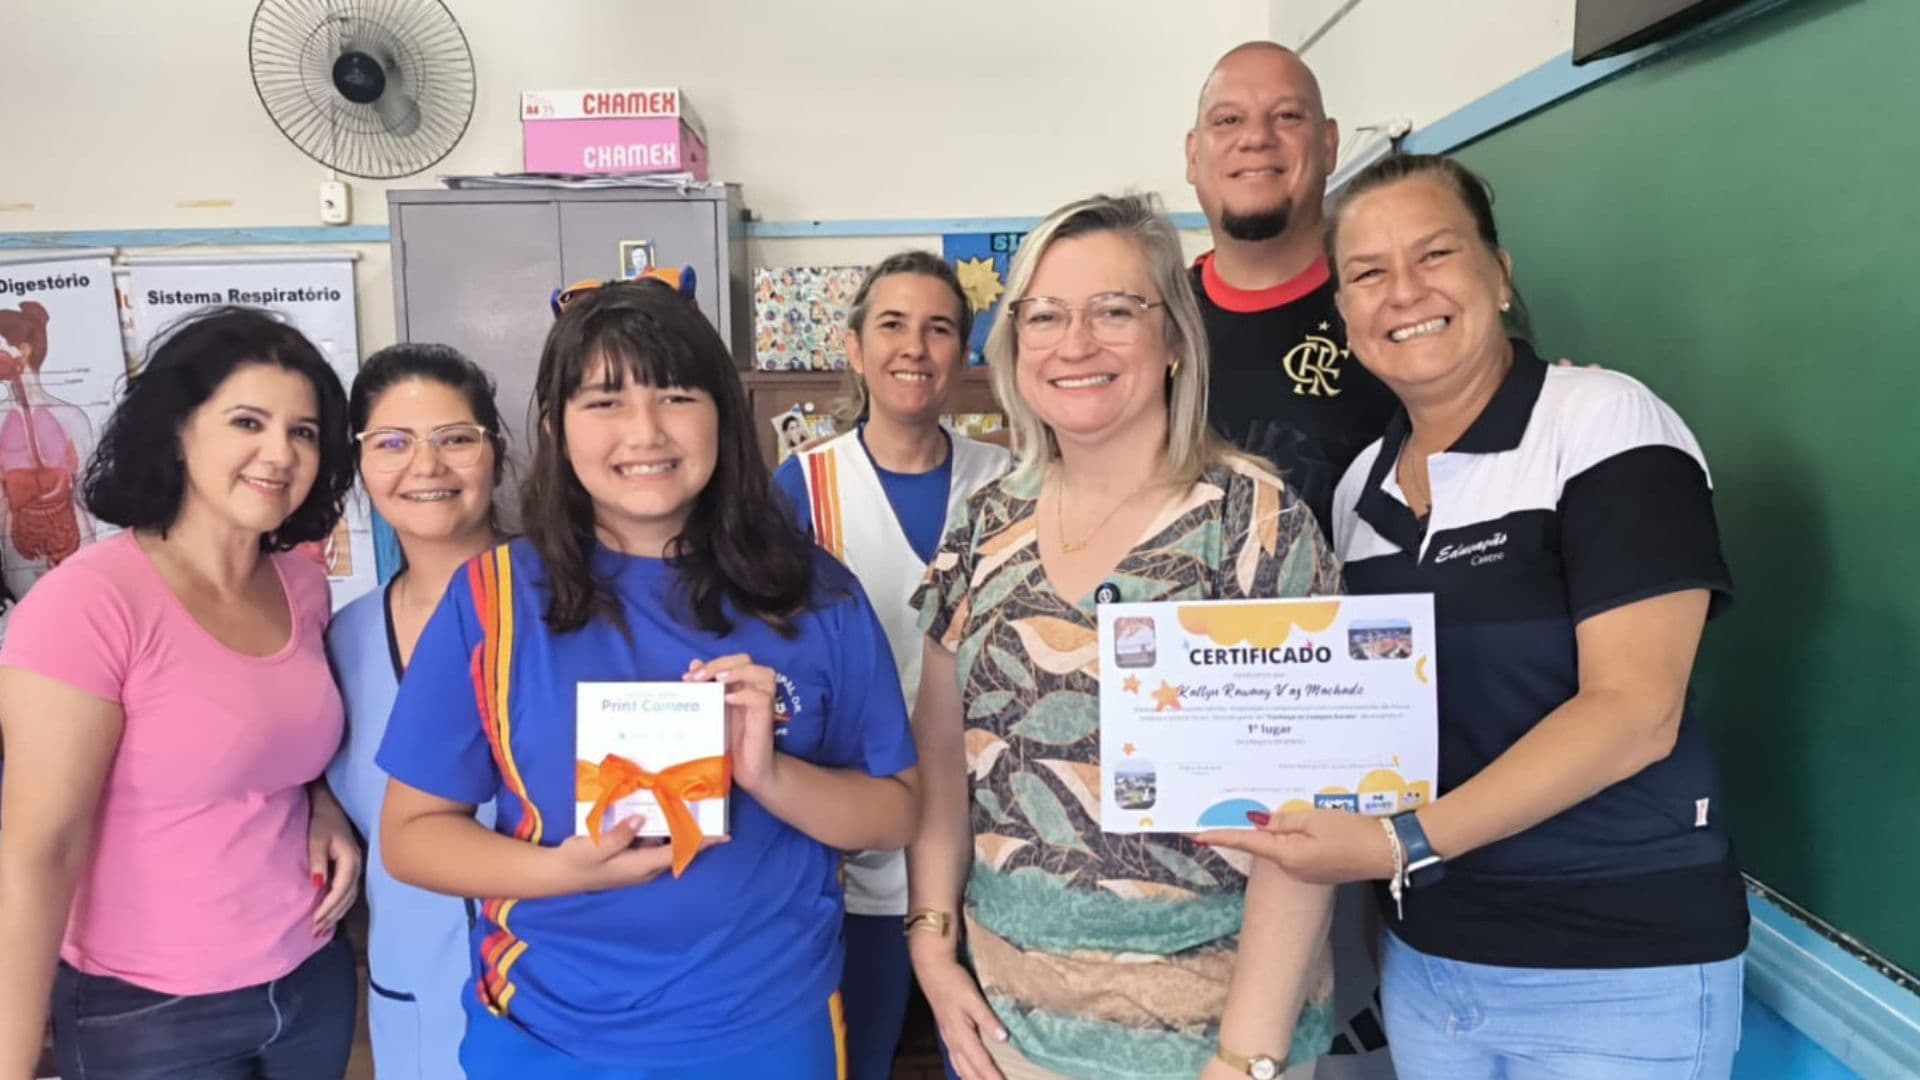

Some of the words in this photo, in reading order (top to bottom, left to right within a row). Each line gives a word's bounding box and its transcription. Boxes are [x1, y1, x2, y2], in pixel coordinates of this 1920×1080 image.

[582, 92, 676, 114] CHAMEX
[583, 142, 677, 169] CHAMEX
[0, 273, 90, 296] Digestório
[147, 289, 222, 305] Sistema
[228, 286, 341, 305] Respiratório
[1434, 532, 1508, 563] Educação
[1470, 551, 1504, 567] Castro
[1189, 645, 1332, 667] CERTIFICADO
[1305, 681, 1365, 698] Machado
[601, 698, 637, 712] Print
[641, 698, 701, 713] Camera
[1261, 723, 1292, 737] lugar
